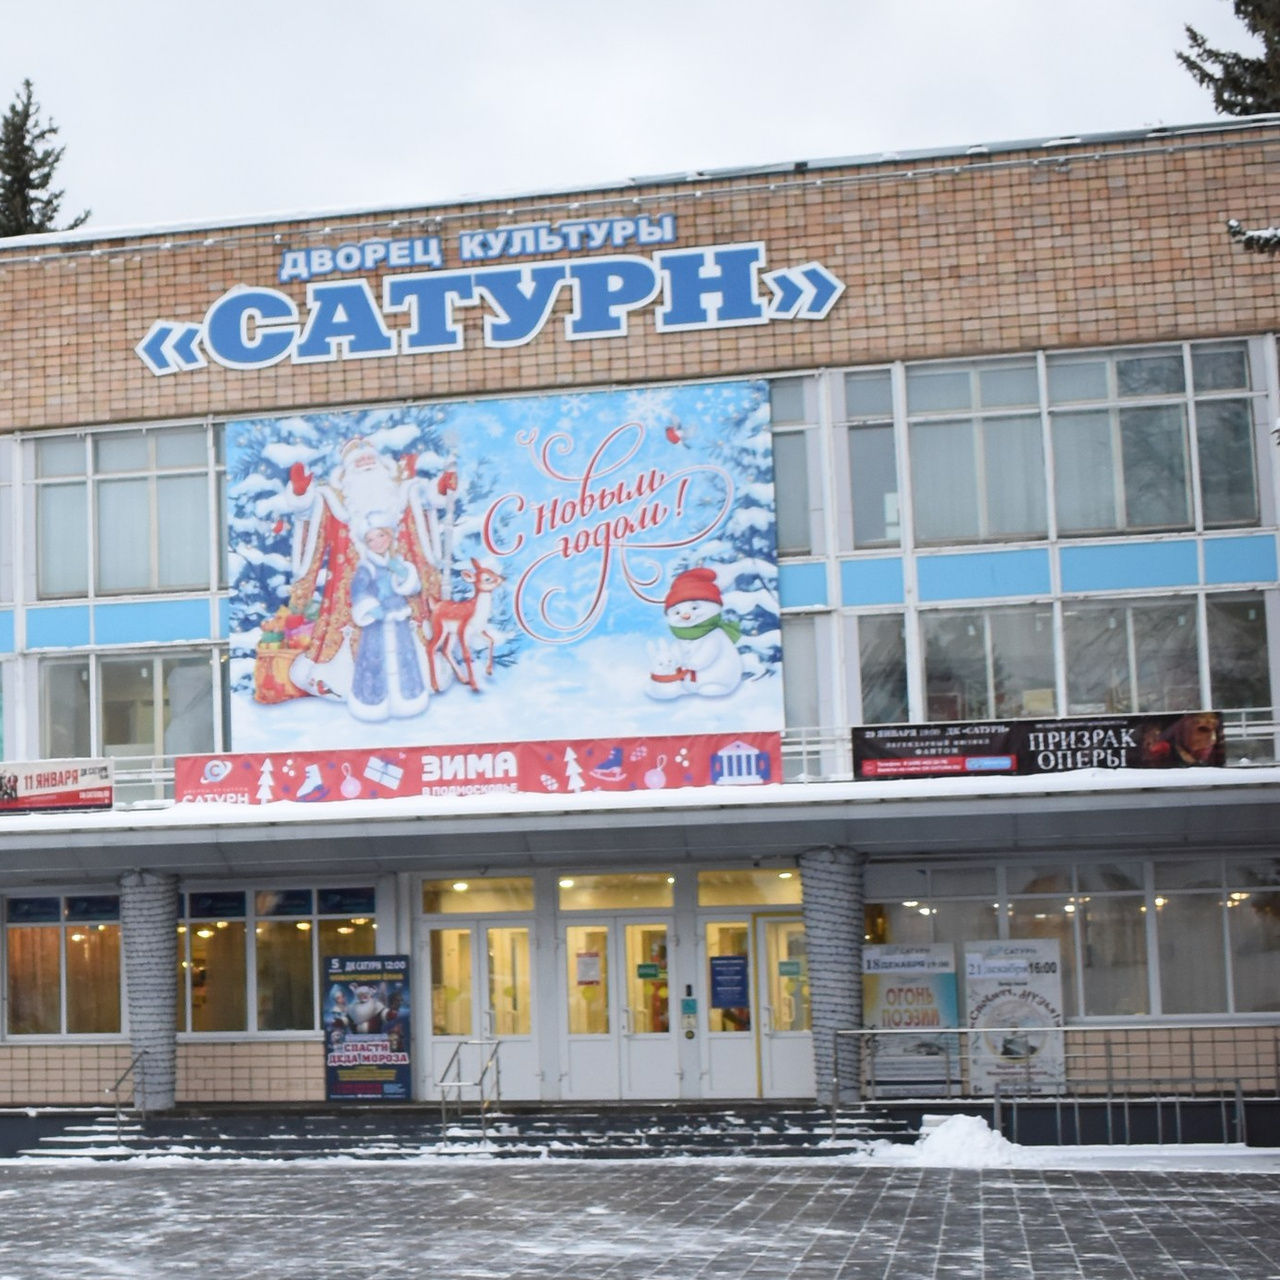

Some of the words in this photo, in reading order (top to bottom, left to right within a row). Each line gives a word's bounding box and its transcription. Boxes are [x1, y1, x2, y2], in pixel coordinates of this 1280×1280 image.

[278, 236, 443, 283] ДВОРЕЦ
[460, 214, 676, 261] КУЛЬТУРЫ
[134, 241, 846, 376] «САТУРН»
[483, 494, 524, 555] С
[525, 435, 665, 535] Новым
[945, 727, 960, 736] ДК
[1029, 728, 1137, 751] ПРИЗРАК
[421, 751, 518, 782] ЗИМА
[1037, 749, 1128, 770] ОПЕРЫ
[24, 775, 33, 790] 11
[36, 769, 78, 788] ЯНВАРЯ
[331, 958, 340, 969] 5
[866, 960, 880, 970] 18
[968, 963, 982, 976] 21
[1028, 961, 1057, 974] 16:00
[886, 987, 934, 1006] ОГОНЬ
[881, 1008, 939, 1028] ПОЭЗИИ
[343, 1042, 390, 1053] СПАСТИ
[328, 1053, 360, 1066] ДЕДА
[361, 1052, 409, 1064] МОРОЗА
